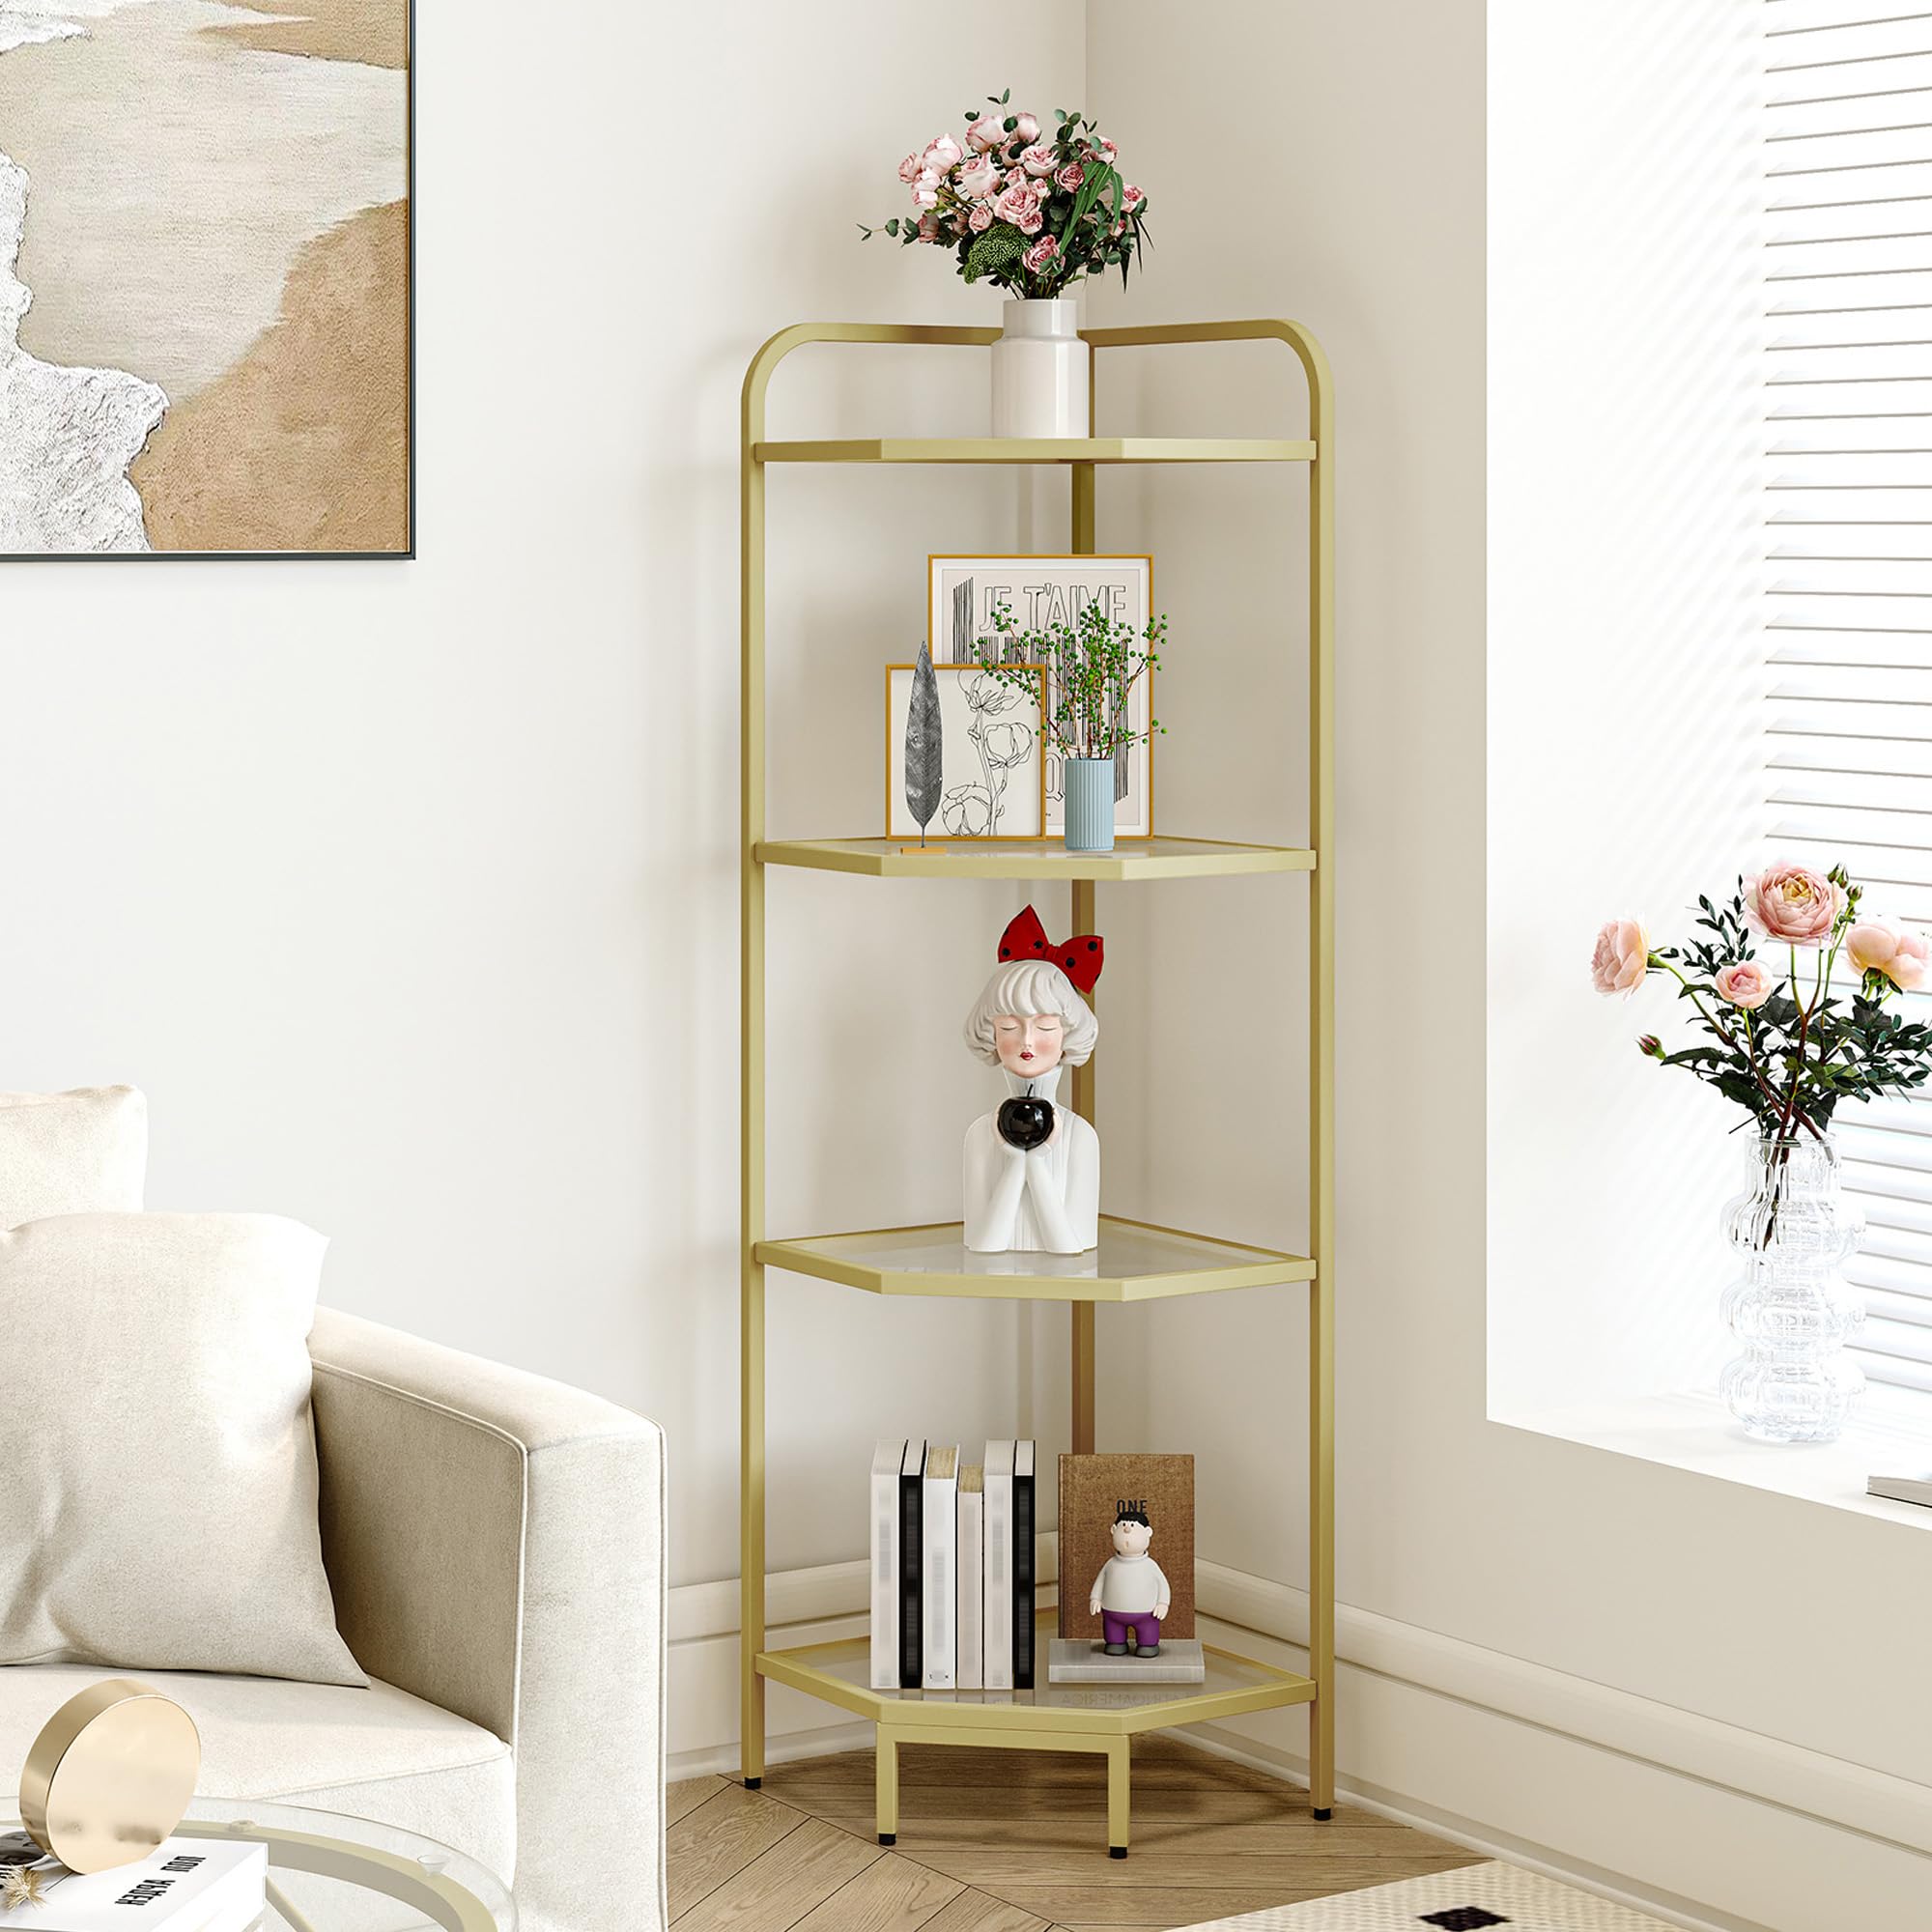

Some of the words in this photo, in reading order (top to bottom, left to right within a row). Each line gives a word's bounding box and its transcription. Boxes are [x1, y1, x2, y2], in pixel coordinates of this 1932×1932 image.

[979, 586, 1011, 631] JE
[1023, 582, 1126, 630] T'AIME
[1117, 1499, 1148, 1514] ONE
